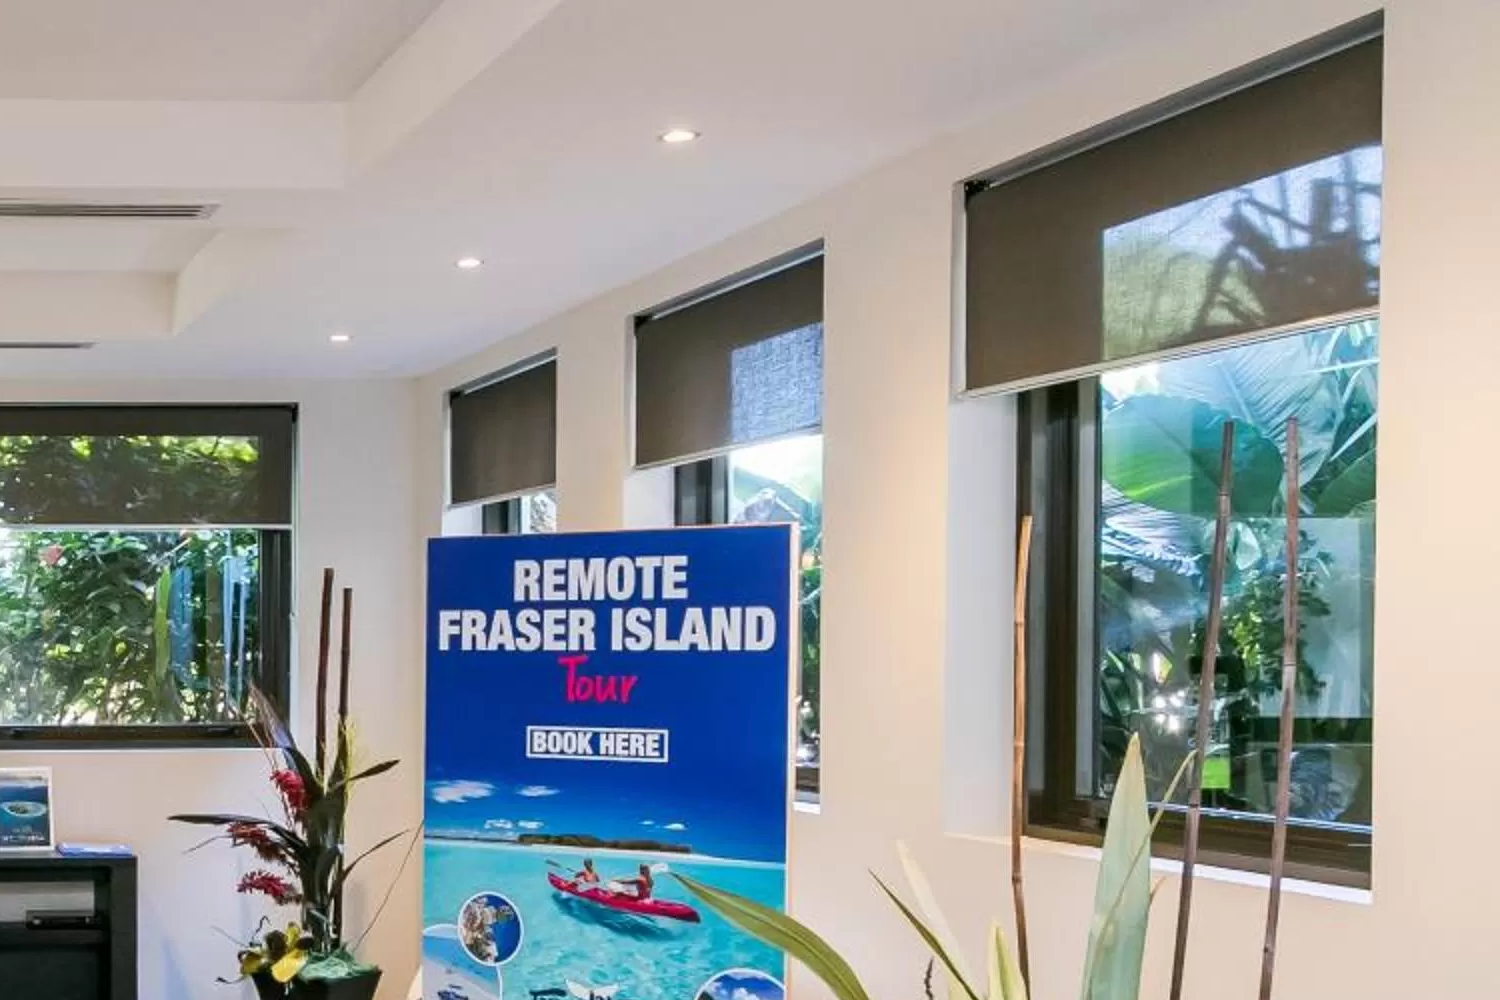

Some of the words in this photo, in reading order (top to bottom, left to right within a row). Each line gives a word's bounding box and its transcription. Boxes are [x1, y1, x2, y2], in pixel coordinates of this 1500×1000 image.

[513, 555, 689, 603] REMOTE
[438, 608, 597, 652] FRASER
[610, 605, 777, 652] ISLAND
[557, 655, 639, 704] Tour
[531, 730, 594, 756] BOOK
[599, 732, 661, 758] HERE
